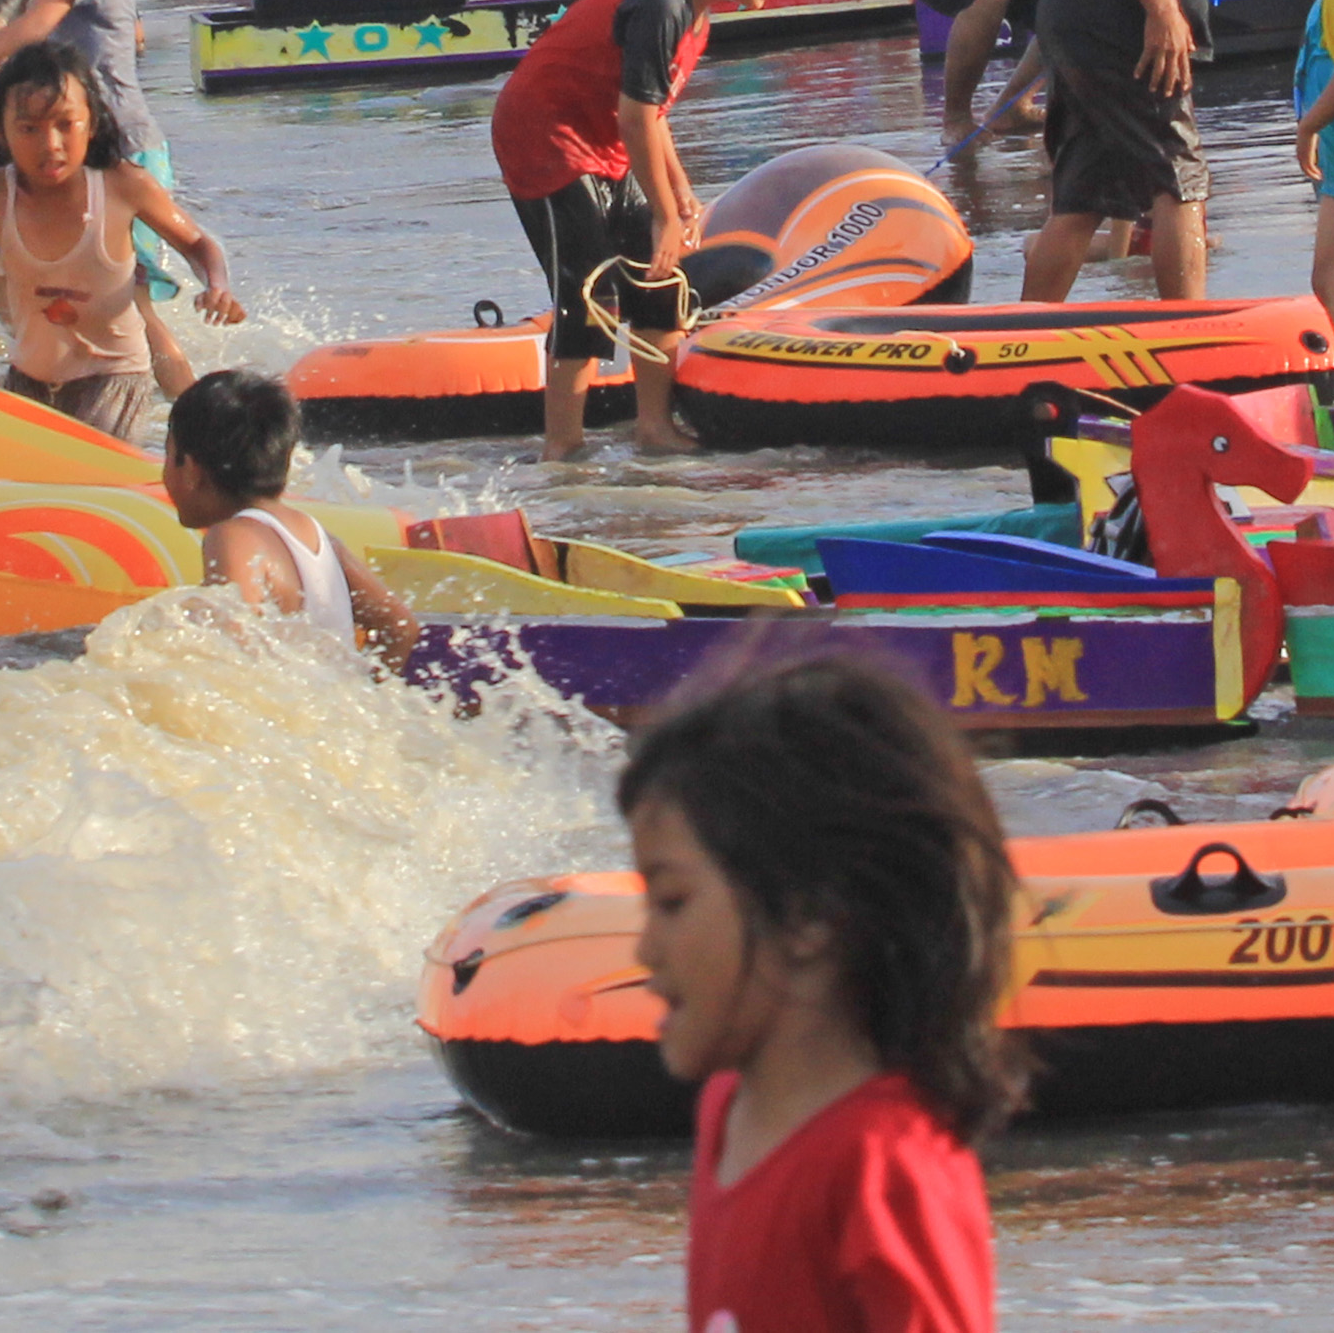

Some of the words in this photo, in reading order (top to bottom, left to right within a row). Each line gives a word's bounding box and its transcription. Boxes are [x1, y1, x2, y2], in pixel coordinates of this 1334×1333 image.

[828, 201, 884, 246] 1000
[726, 331, 866, 357] EXPLORER
[870, 343, 931, 360] PRO
[998, 343, 1028, 358] 50
[1228, 915, 1332, 965] 200
